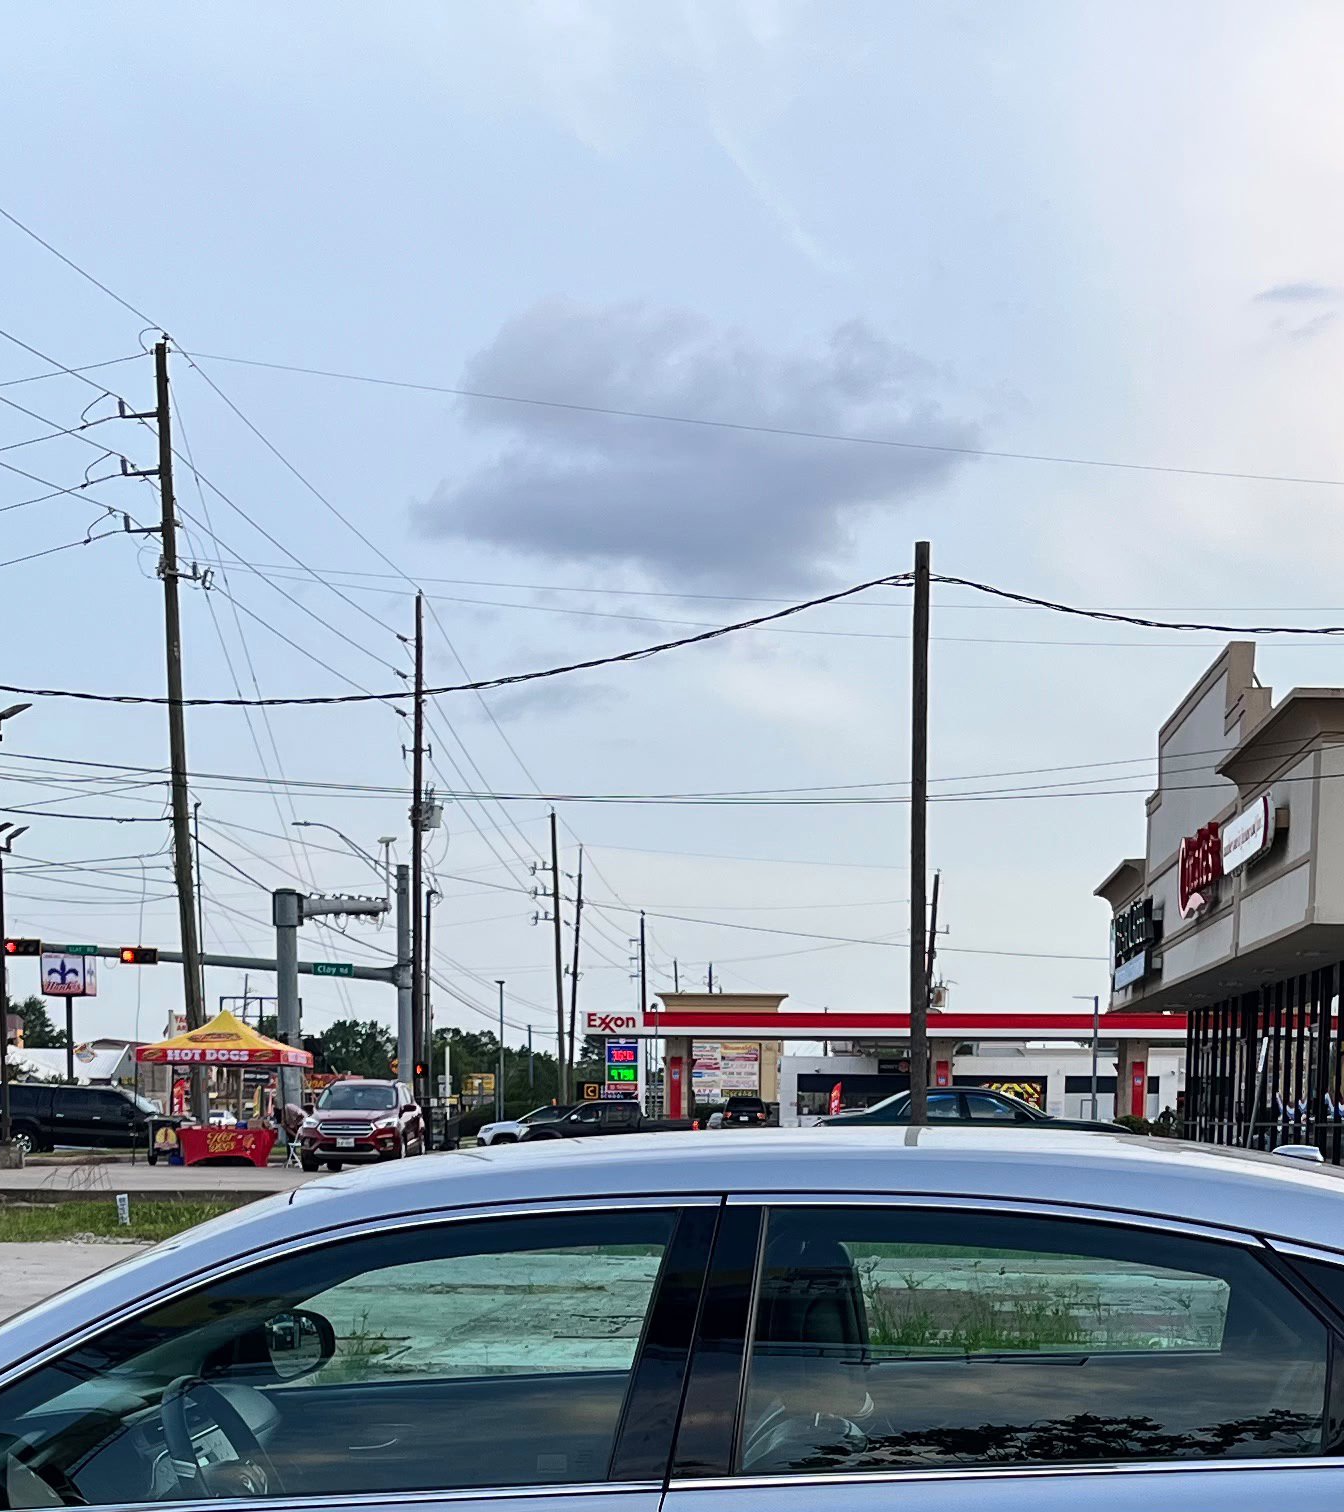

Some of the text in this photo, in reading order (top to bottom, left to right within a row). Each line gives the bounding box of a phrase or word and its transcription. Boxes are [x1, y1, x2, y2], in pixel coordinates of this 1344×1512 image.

[317, 965, 337, 975] Clay
[586, 1012, 636, 1034] Exxon
[166, 1049, 250, 1061] HOT DOGS
